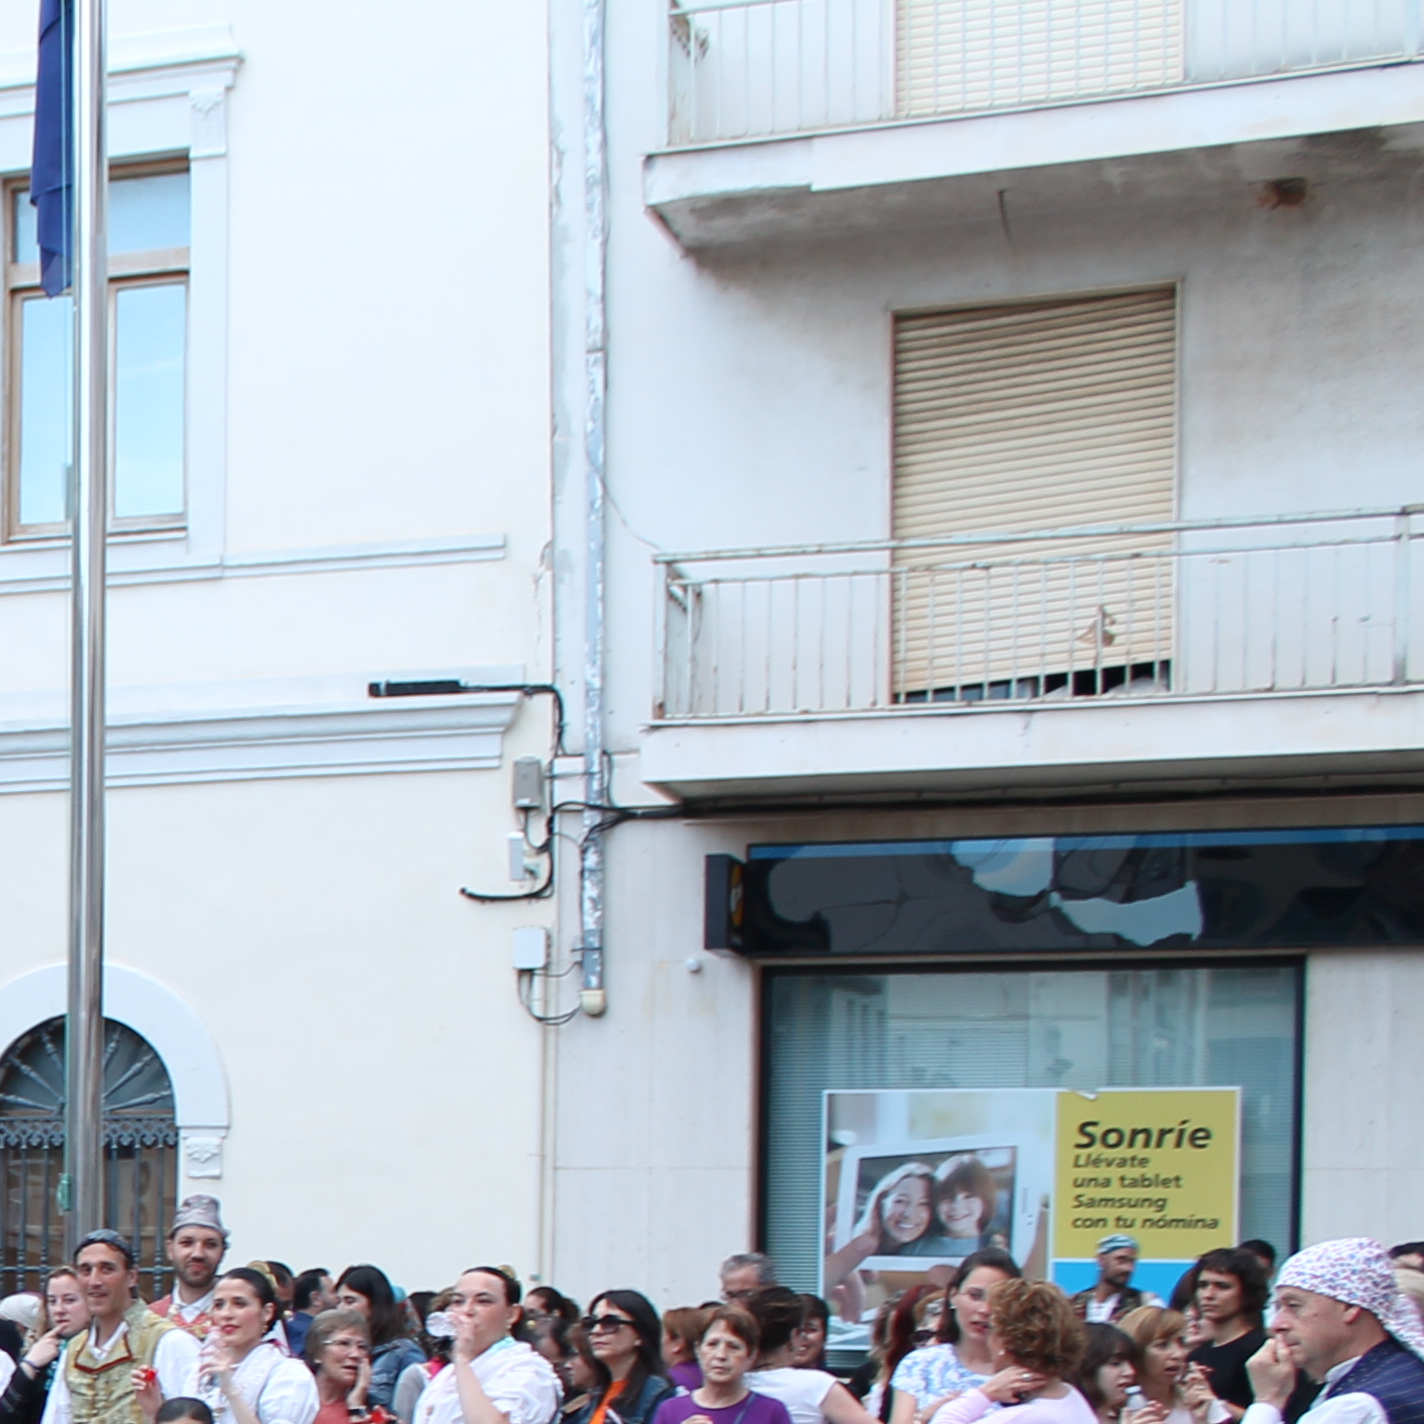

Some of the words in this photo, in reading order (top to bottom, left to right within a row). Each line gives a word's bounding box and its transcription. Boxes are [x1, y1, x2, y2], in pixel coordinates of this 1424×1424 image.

[1073, 1119, 1213, 1149] Sonríe
[1073, 1153, 1151, 1169] Llévate
[1073, 1175, 1112, 1189] una
[1119, 1174, 1183, 1189] tablet
[1072, 1194, 1169, 1213] Samsung
[1072, 1216, 1108, 1229] con
[1114, 1215, 1135, 1229] tu
[1141, 1215, 1220, 1229] nómina
